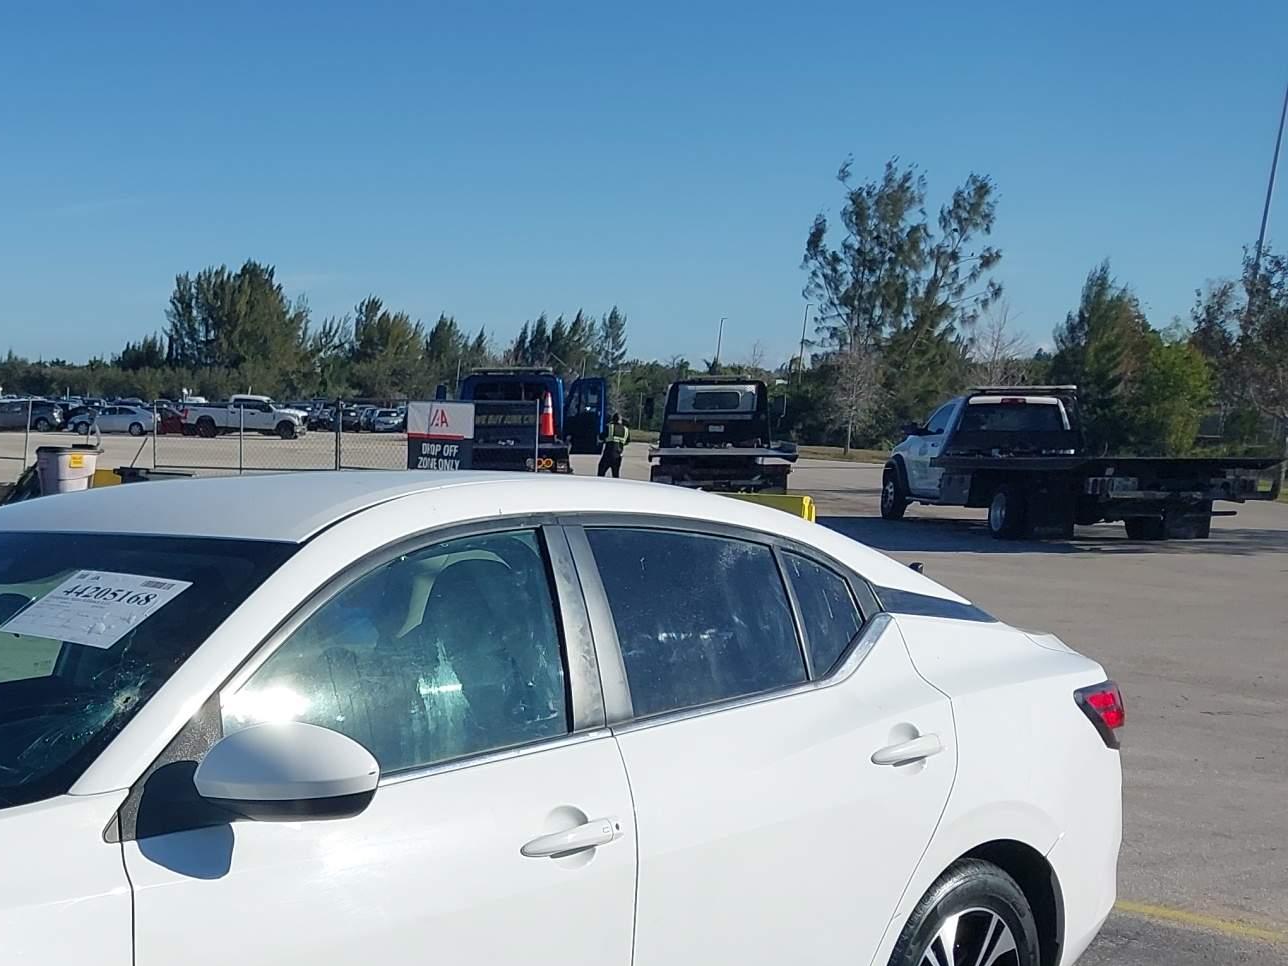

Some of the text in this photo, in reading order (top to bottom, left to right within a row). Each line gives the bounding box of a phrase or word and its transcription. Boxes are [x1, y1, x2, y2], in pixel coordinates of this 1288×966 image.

[422, 443, 459, 457] DROP OFF
[417, 457, 460, 471] ZONE ONLY
[63, 584, 158, 606] 44205168
